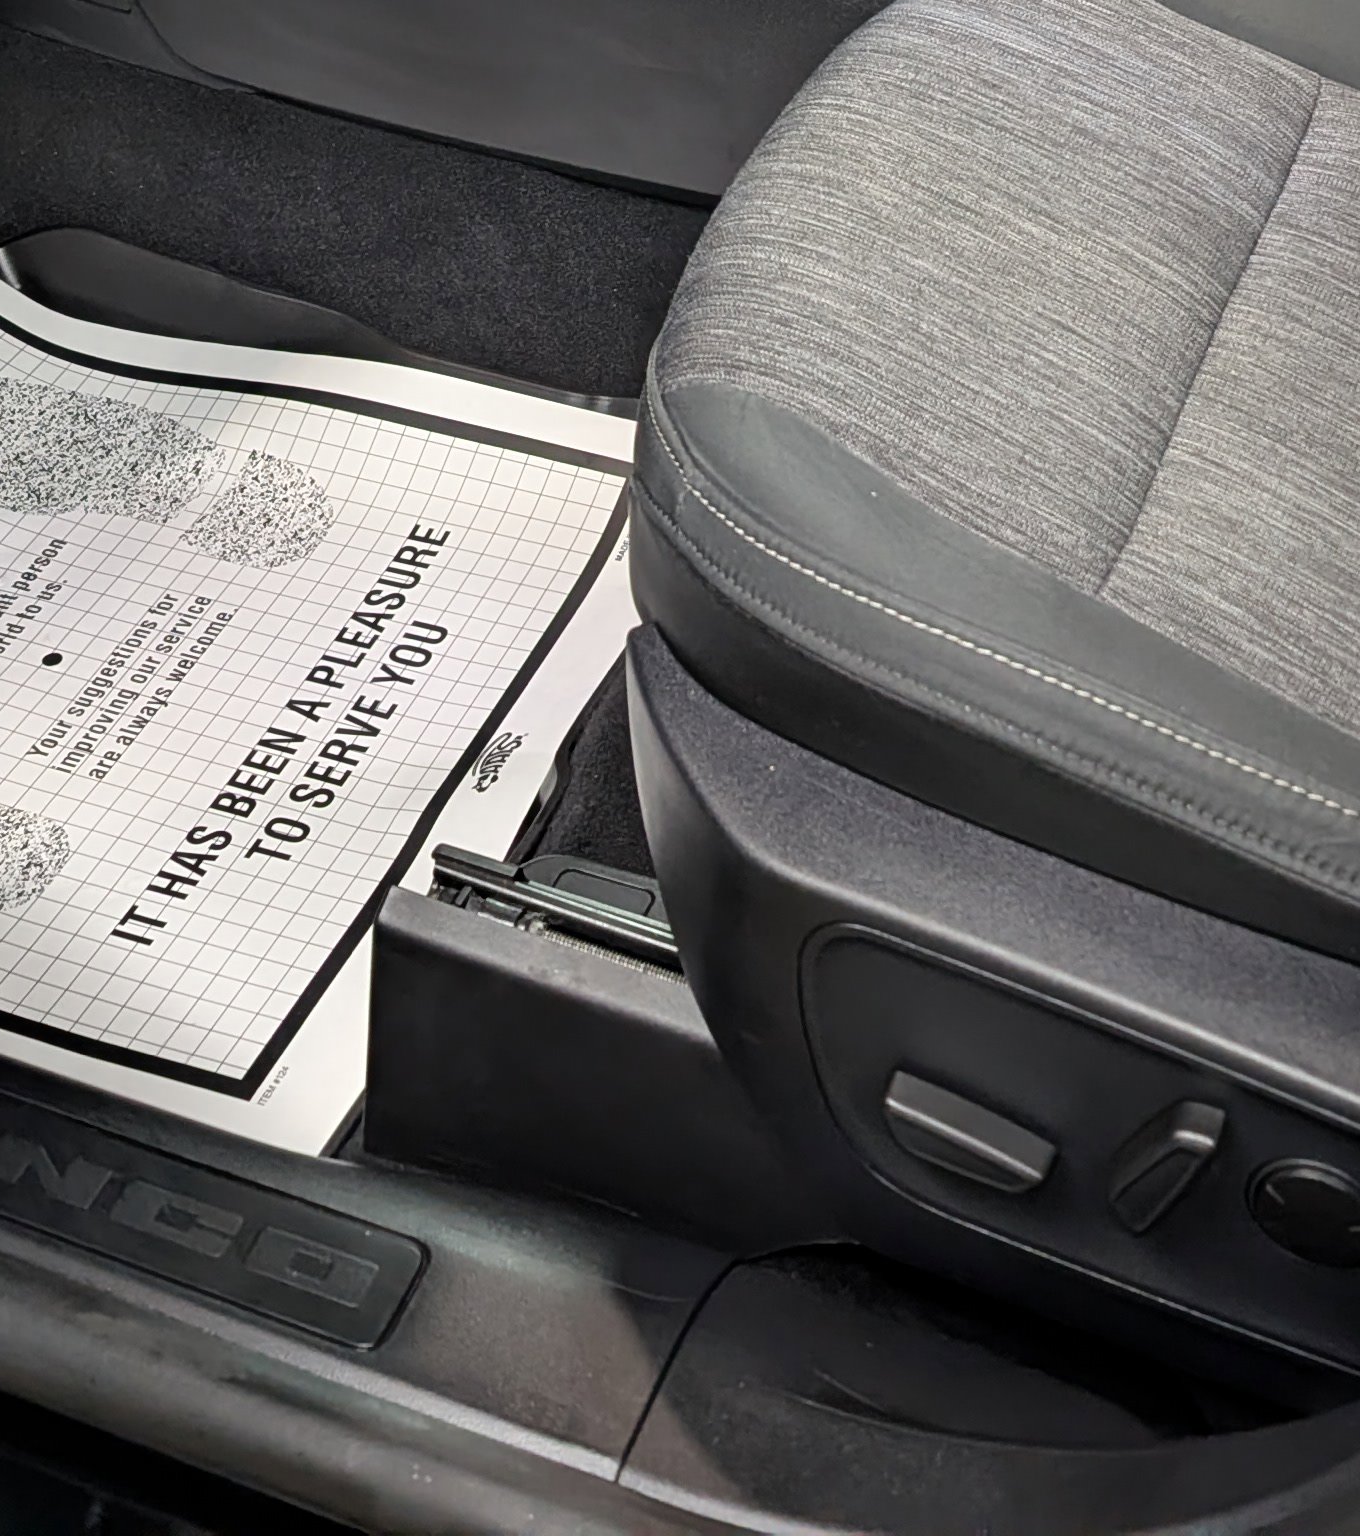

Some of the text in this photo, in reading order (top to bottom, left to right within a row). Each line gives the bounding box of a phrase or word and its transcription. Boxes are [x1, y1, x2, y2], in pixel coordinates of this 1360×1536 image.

[11, 538, 67, 592] person
[16, 604, 42, 621] to
[37, 579, 68, 602] us.
[26, 593, 179, 758] Your suggestions for
[51, 595, 212, 774] improving our service
[88, 608, 238, 780] are always welcome.
[110, 523, 452, 947] IT HAS BEEN A PLEASURE
[244, 619, 449, 862] TO SERVE YOU
[257, 1084, 277, 1106] ITEM
